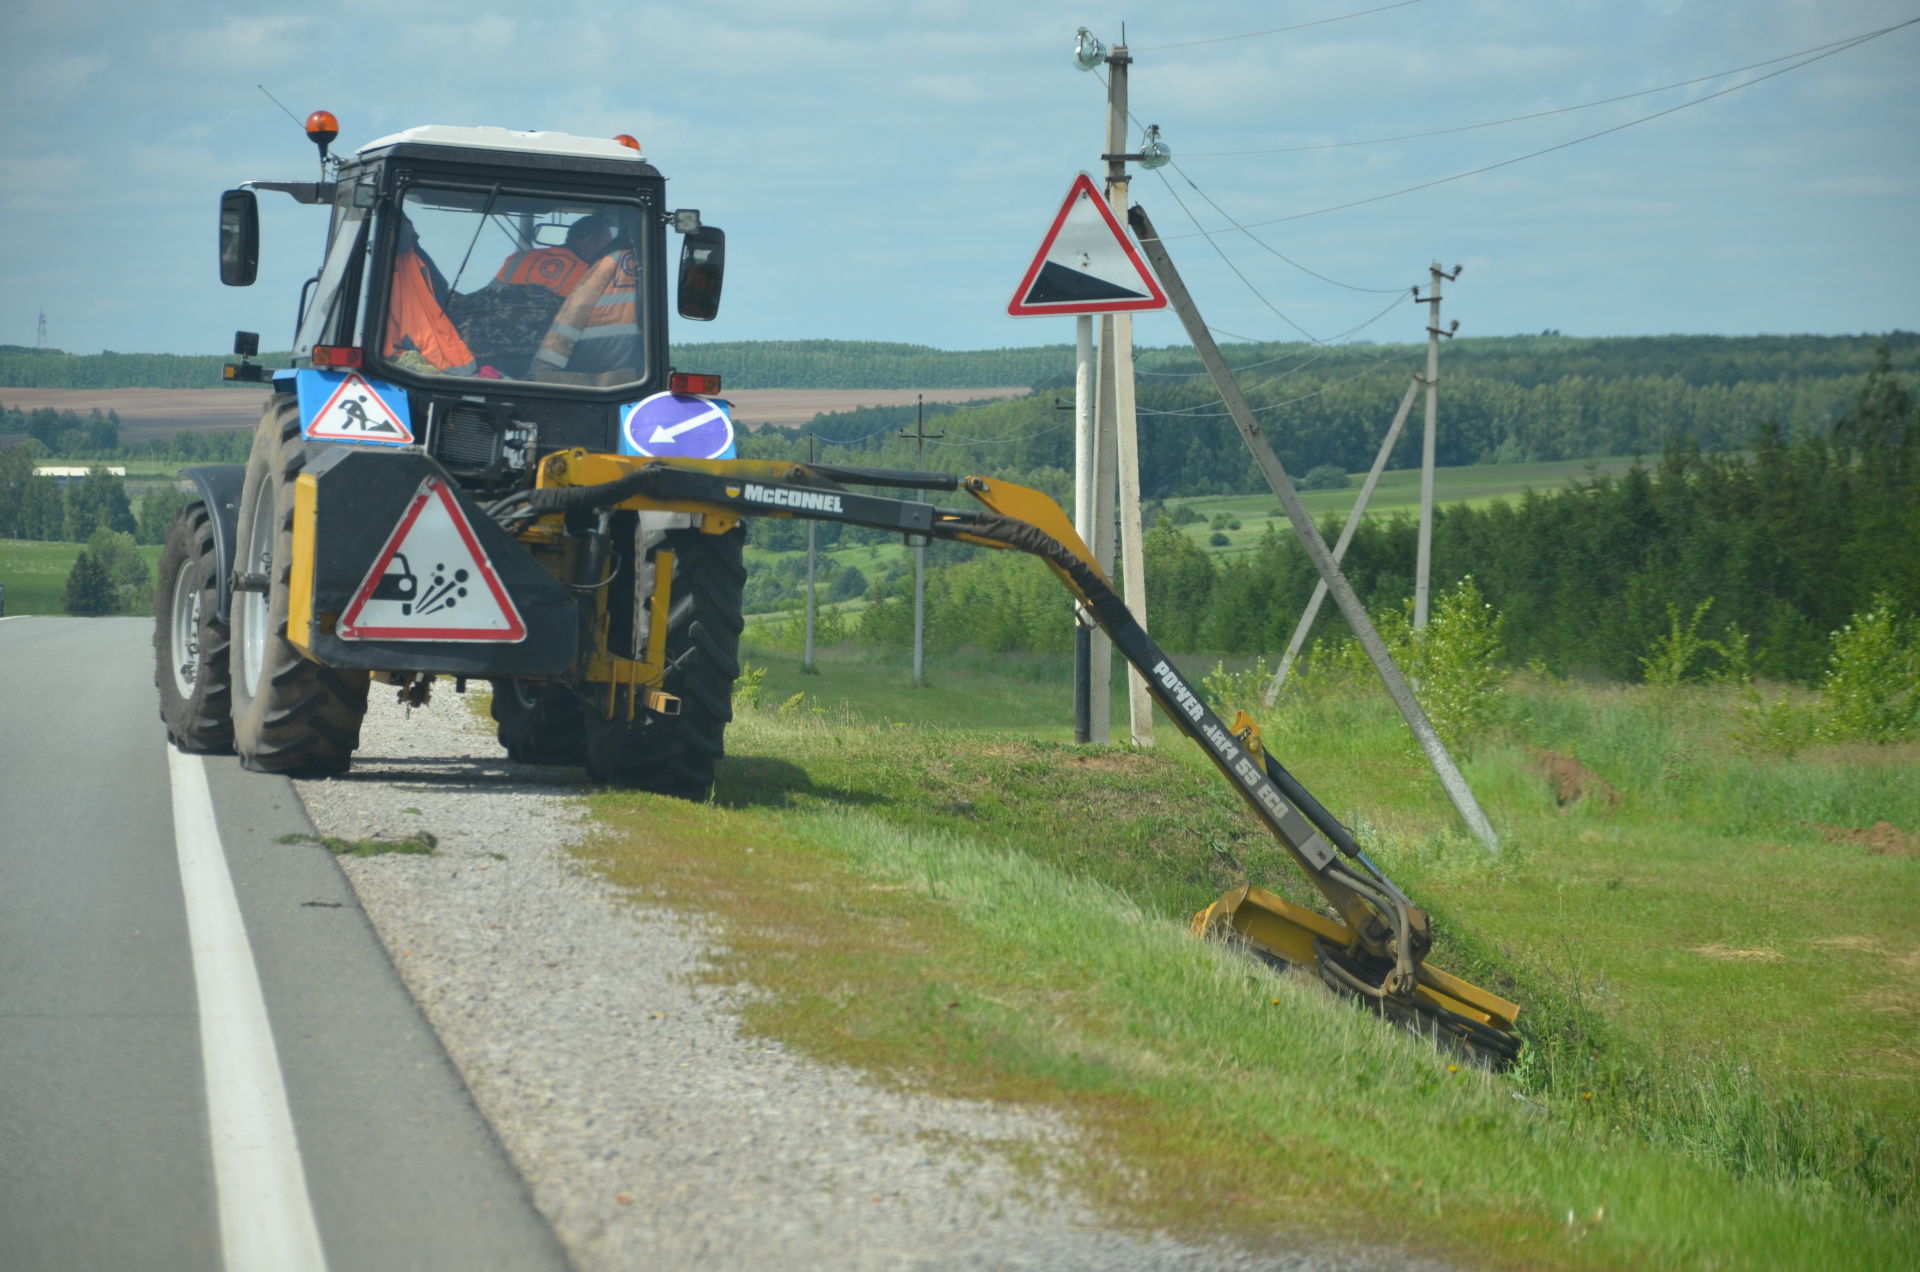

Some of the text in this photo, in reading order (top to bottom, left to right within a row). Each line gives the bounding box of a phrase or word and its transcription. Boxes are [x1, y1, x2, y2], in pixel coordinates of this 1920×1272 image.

[744, 483, 844, 513] McCONNEL
[1152, 660, 1204, 722] POWER
[1234, 758, 1262, 787] 55
[1257, 784, 1289, 819] ECO
